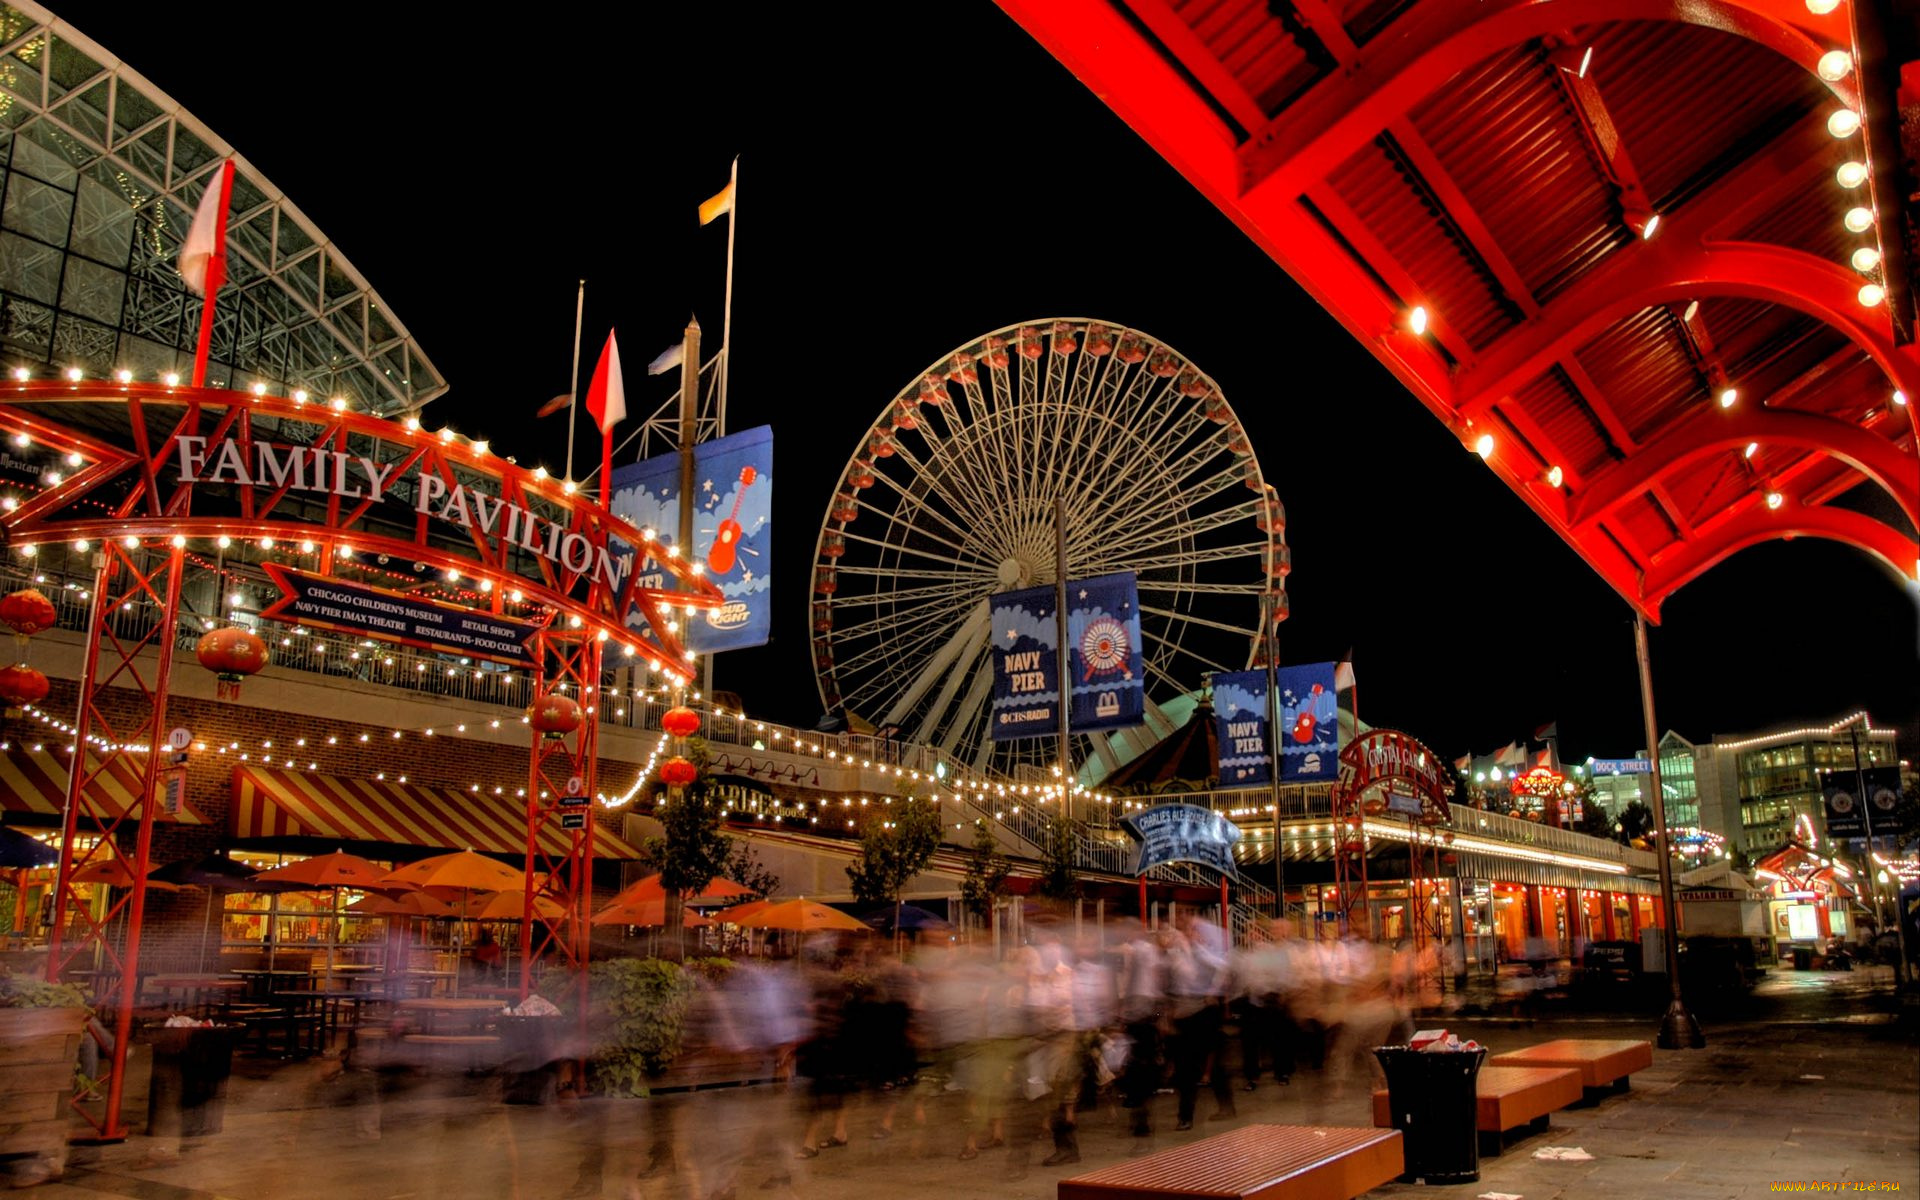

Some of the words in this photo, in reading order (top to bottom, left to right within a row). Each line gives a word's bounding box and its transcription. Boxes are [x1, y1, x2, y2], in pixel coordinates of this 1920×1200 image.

[1, 452, 40, 474] Mexican
[174, 435, 393, 503] FAMILY
[414, 472, 625, 593] PAVILION
[634, 573, 664, 590] IER
[307, 587, 352, 604] CHICAGO
[352, 596, 405, 616] CHILDREN'S
[405, 608, 443, 624] MUSEUM
[295, 601, 320, 613] NAVY
[321, 606, 341, 618] PIER
[342, 610, 367, 623] IMAX
[367, 615, 407, 631] THEATRE
[461, 619, 489, 633] RETAIL
[489, 626, 516, 639] SHOPS
[496, 642, 523, 655] COURT
[1004, 651, 1041, 674] NAVY
[1011, 671, 1046, 693] PIER
[1227, 721, 1259, 738] NAVY
[1235, 738, 1264, 754] PIER
[1595, 762, 1617, 772] DOCK
[1620, 760, 1649, 771] STREET
[1678, 891, 1717, 900] ITALIAN
[1718, 891, 1734, 899] ICE
